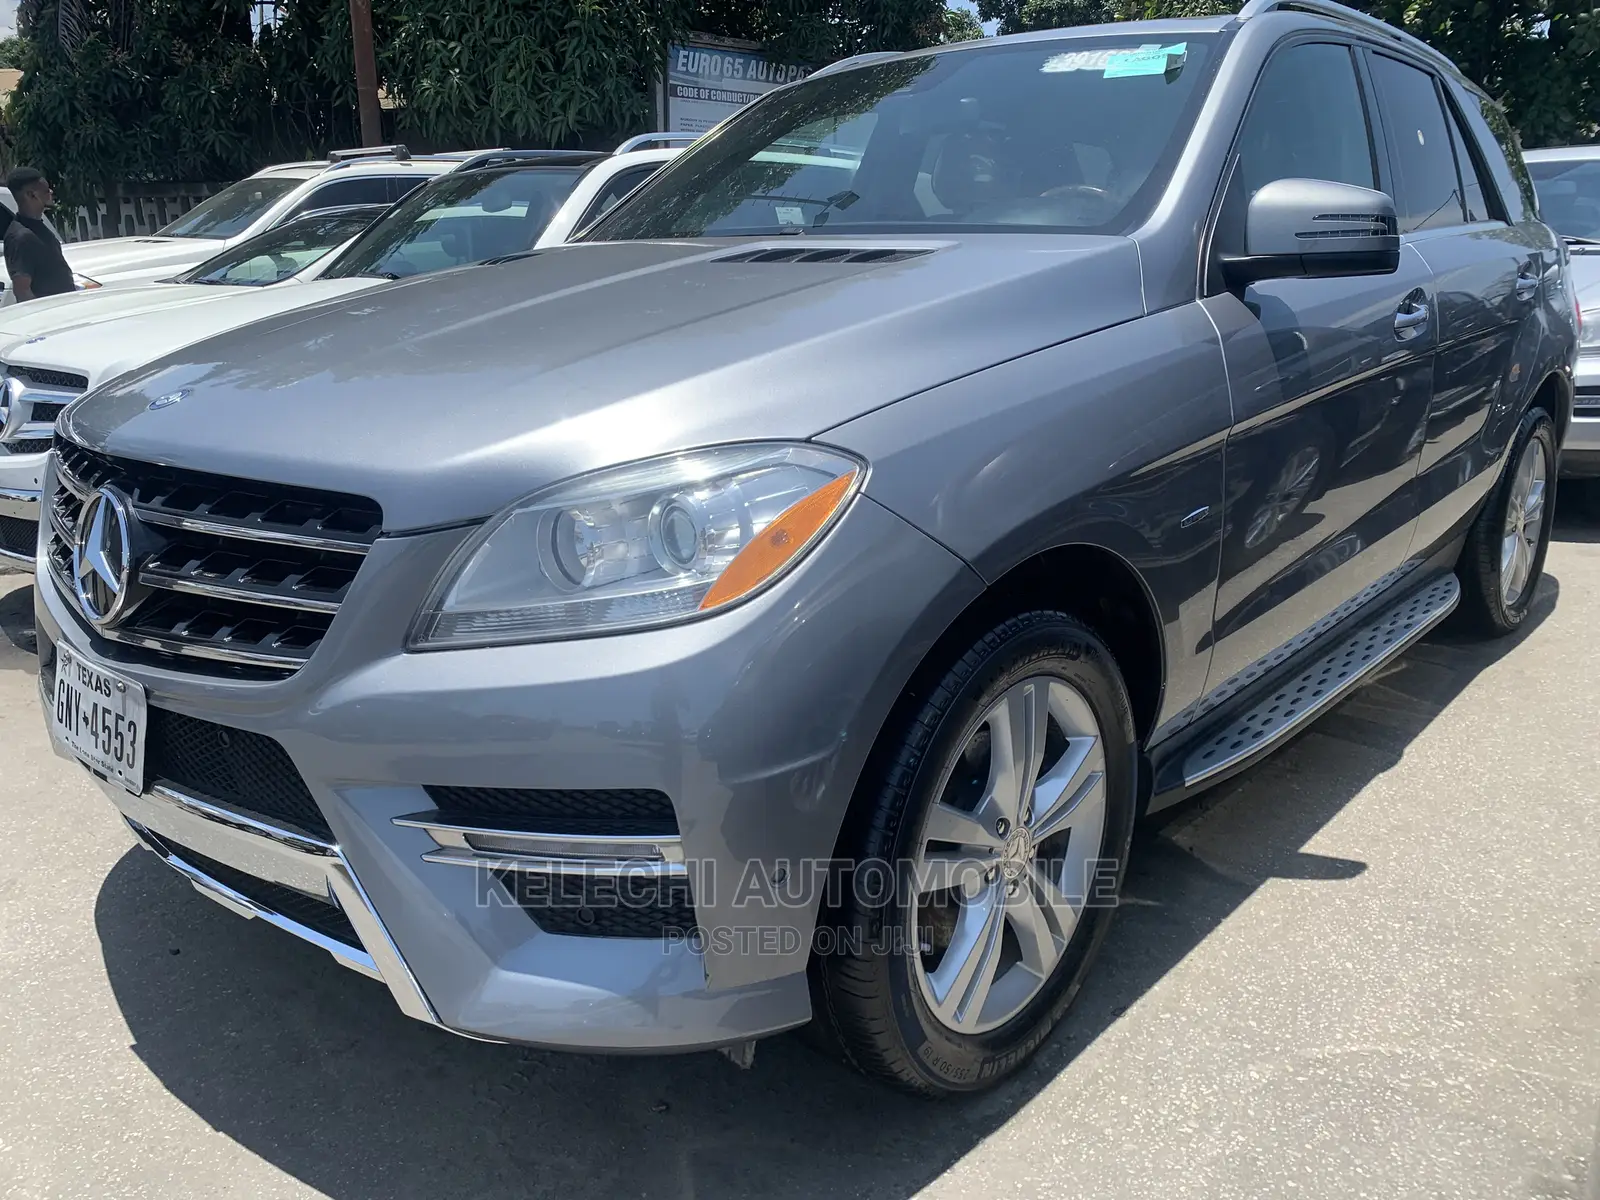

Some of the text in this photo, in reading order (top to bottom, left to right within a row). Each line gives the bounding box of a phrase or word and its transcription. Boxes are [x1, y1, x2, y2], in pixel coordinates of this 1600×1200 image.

[677, 86, 699, 98] CODE
[700, 88, 710, 100] OF
[76, 663, 111, 698] TEXAS
[57, 678, 137, 769] GNY 4553
[923, 1045, 933, 1062] 19
[940, 1062, 970, 1080] 255/50
